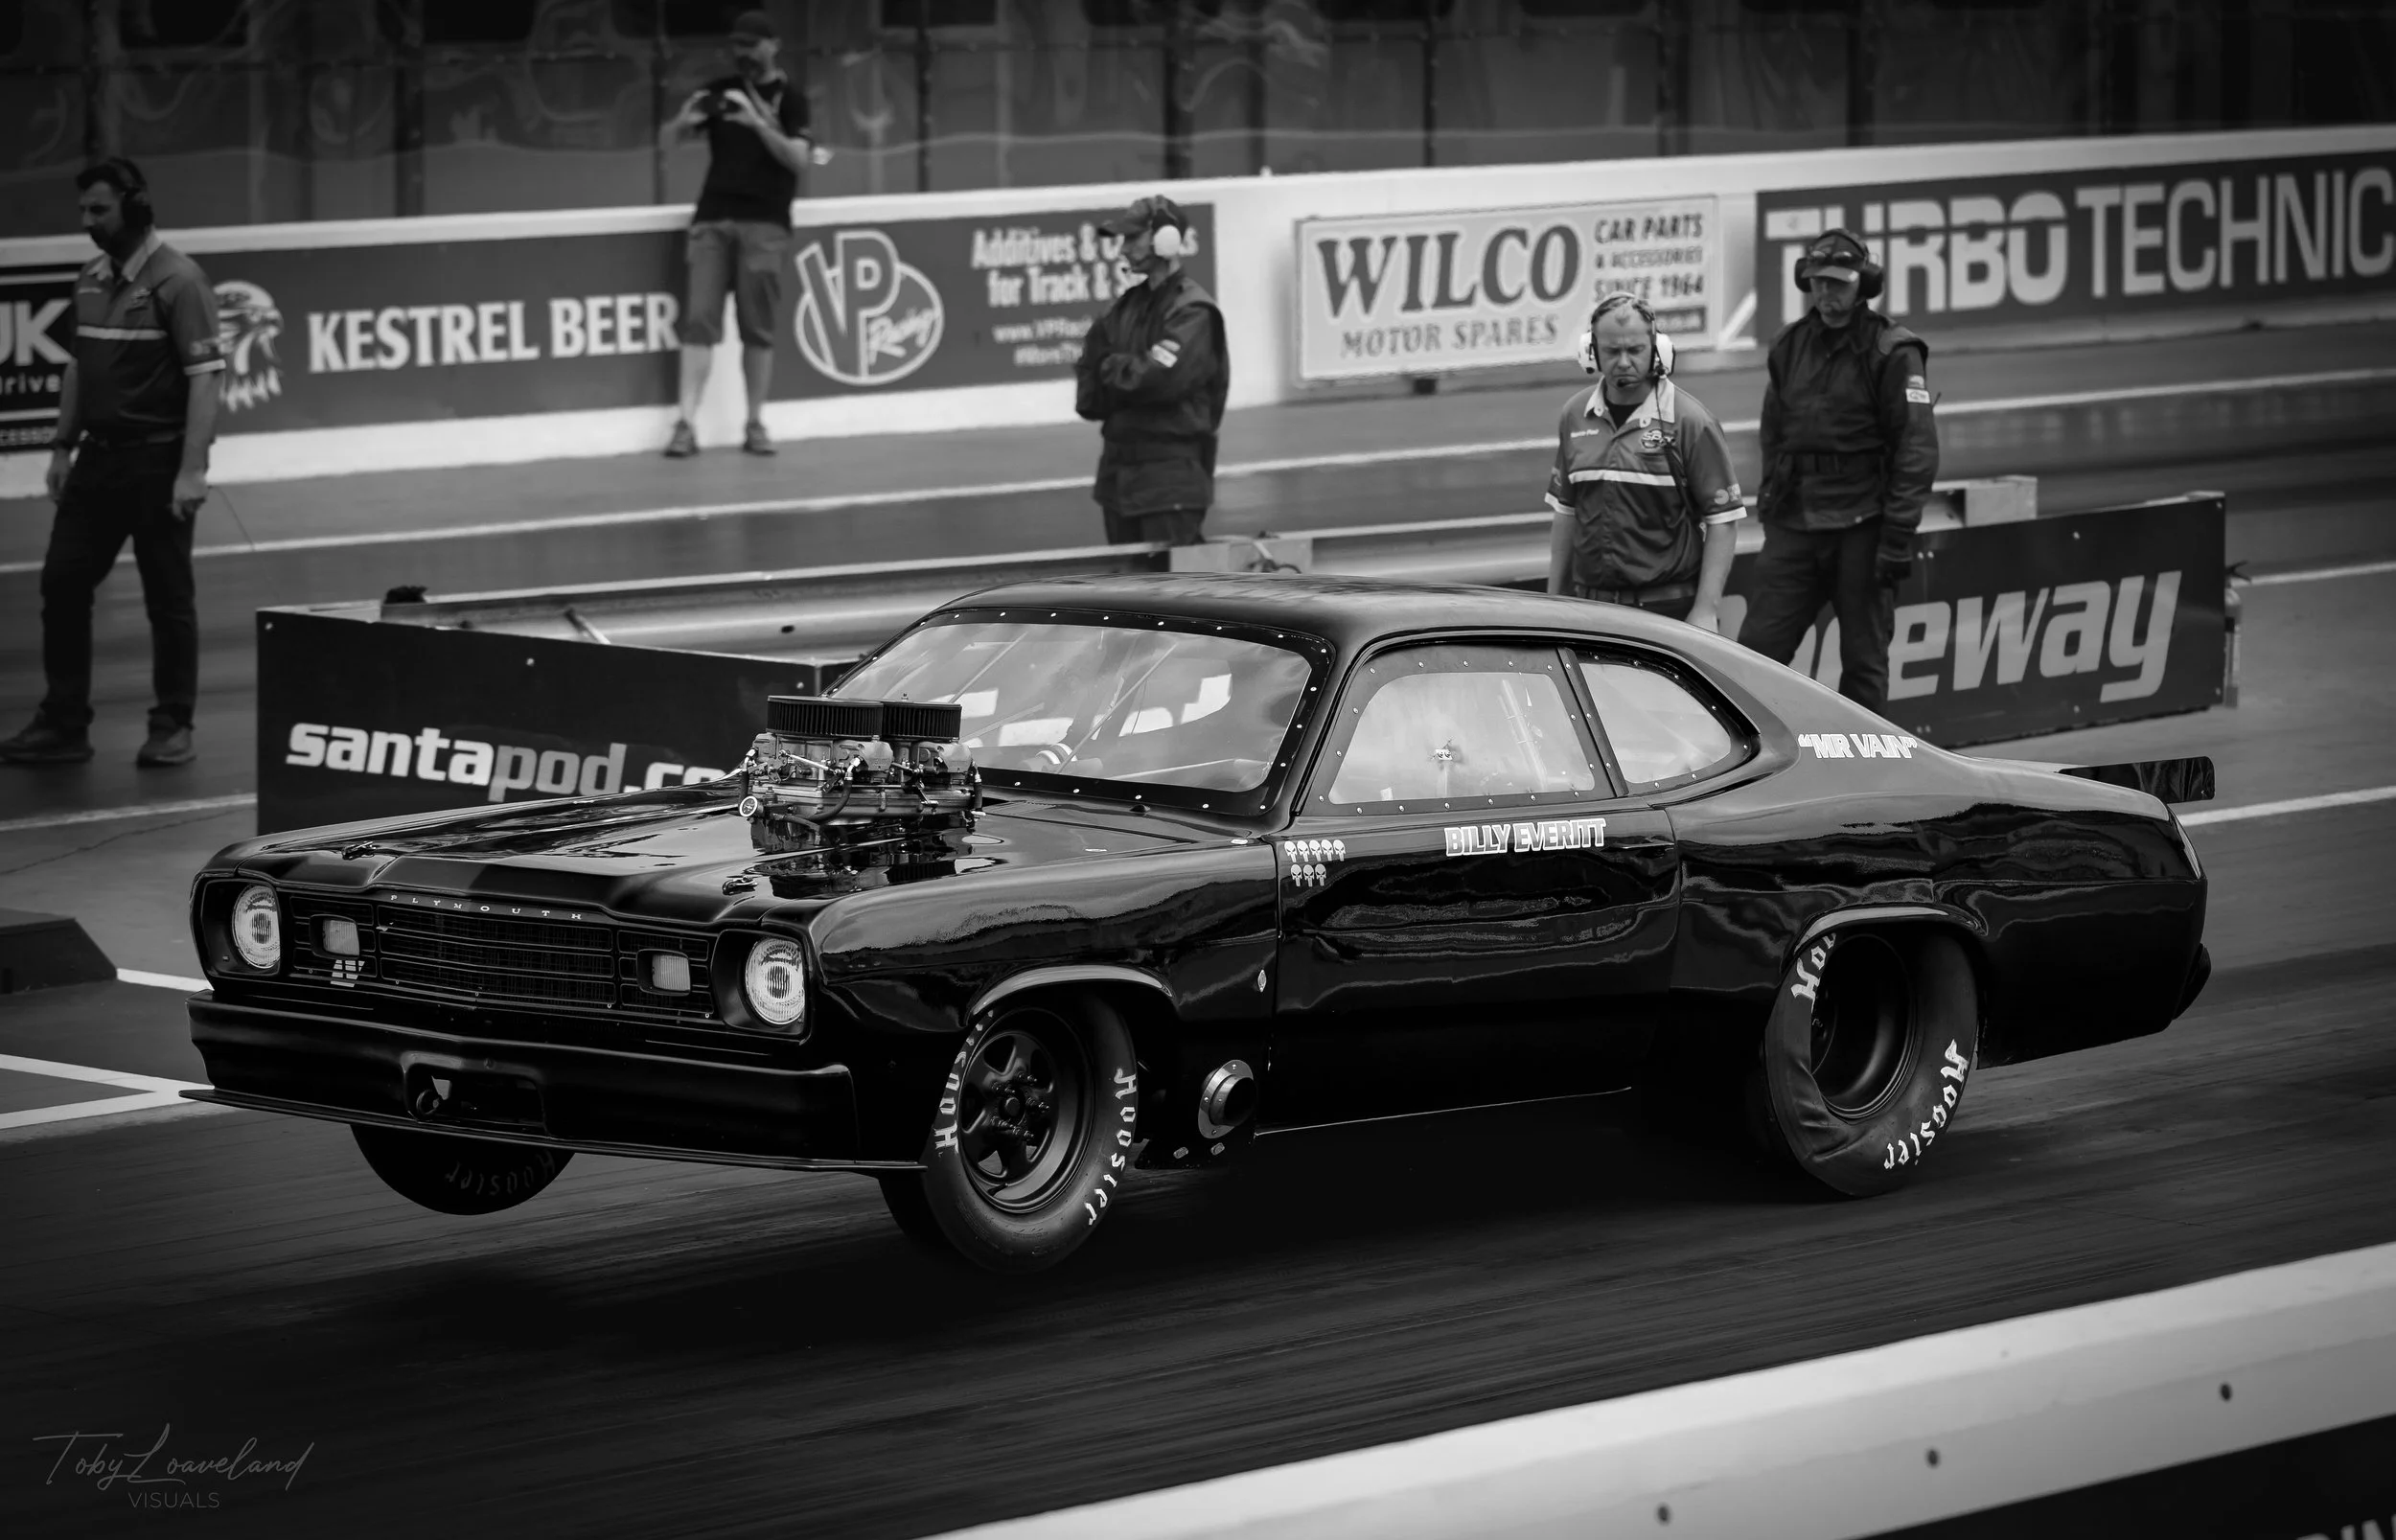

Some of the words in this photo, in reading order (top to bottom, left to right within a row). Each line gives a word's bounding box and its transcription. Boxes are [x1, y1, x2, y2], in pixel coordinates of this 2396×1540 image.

[971, 226, 1077, 269] Additives
[1078, 221, 1098, 264] &
[1594, 218, 1635, 244] CAR
[1641, 213, 1703, 241] PARTS
[987, 268, 1024, 308] for
[1026, 261, 1090, 306] Track
[1093, 261, 1113, 301] &
[1317, 223, 1580, 319] WILCO
[795, 229, 902, 383] VP
[307, 301, 540, 374] KESTREL
[549, 291, 681, 358] BEER
[1341, 323, 1440, 360] MOTOR
[1452, 312, 1557, 352] SPARES
[0, 372, 62, 395] rive
[1444, 824, 1511, 857] BILLY
[1513, 817, 1607, 853] EVERITT
[390, 893, 584, 921] PLYMOUTH
[1883, 1038, 1969, 1170] Hoosier
[1084, 1067, 1138, 1227] Hoosier
